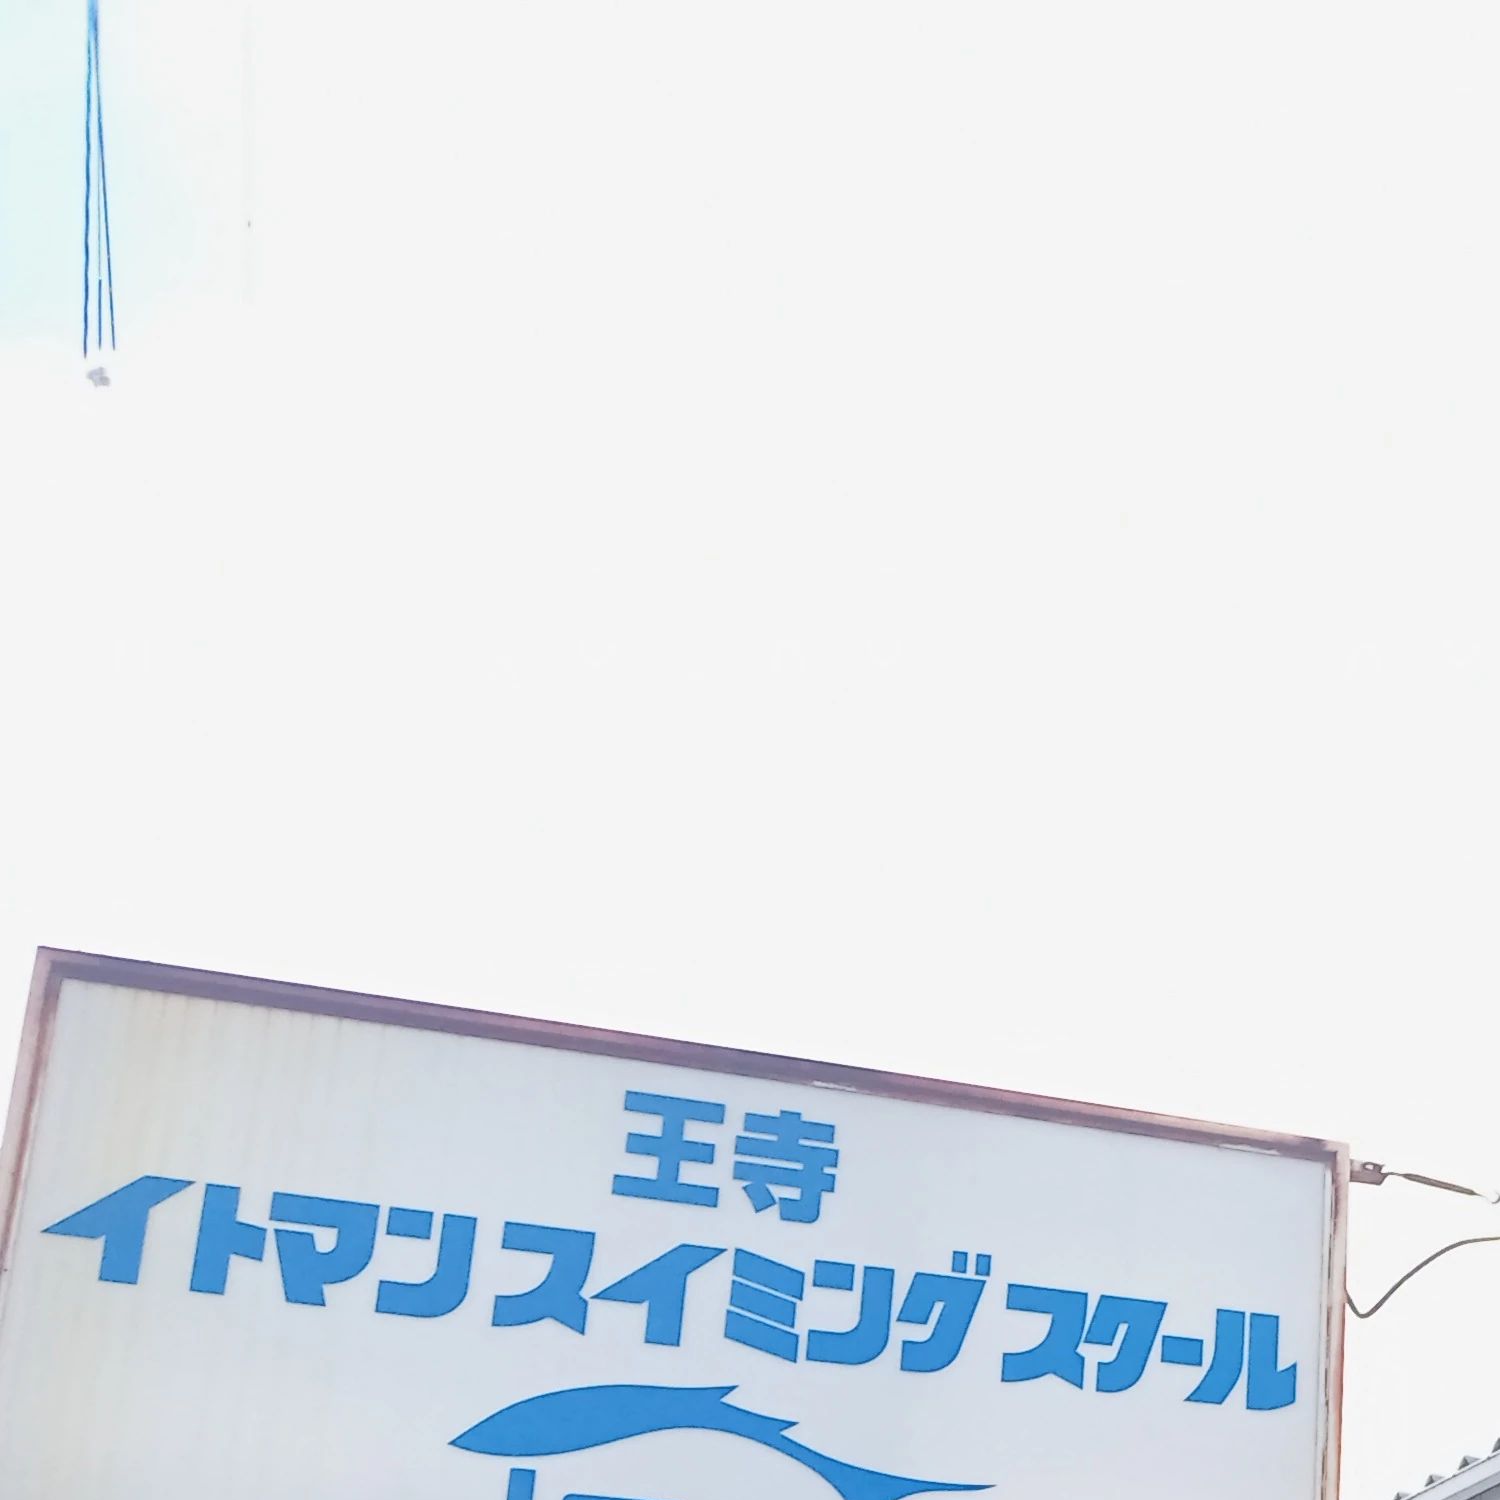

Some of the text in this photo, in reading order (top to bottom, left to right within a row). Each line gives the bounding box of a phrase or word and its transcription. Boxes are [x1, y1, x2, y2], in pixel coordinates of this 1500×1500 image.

[611, 1089, 841, 1225] 王寺
[43, 1173, 1299, 1413] イトマンスイミングスクール
